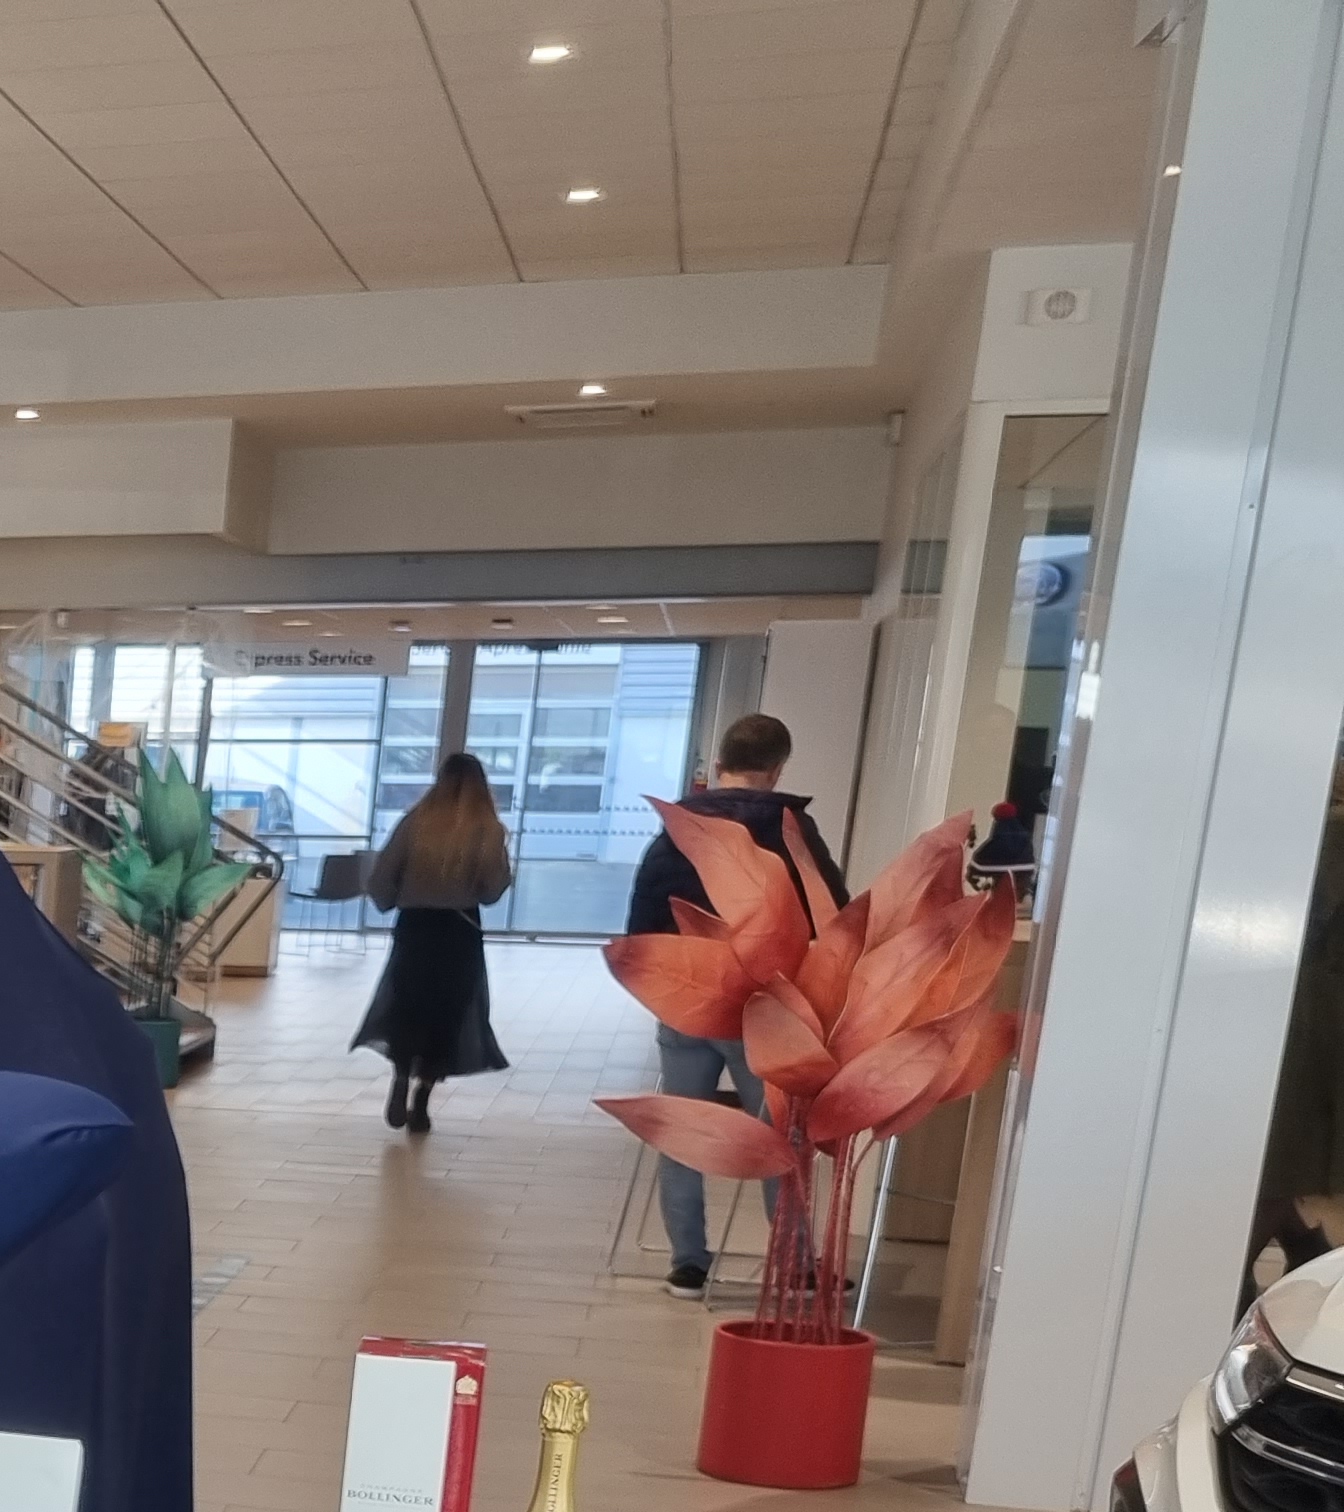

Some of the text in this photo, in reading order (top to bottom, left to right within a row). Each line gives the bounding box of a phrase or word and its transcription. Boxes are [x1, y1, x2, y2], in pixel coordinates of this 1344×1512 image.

[234, 648, 374, 669] Epress Service
[347, 1489, 434, 1506] BOLLINGER
